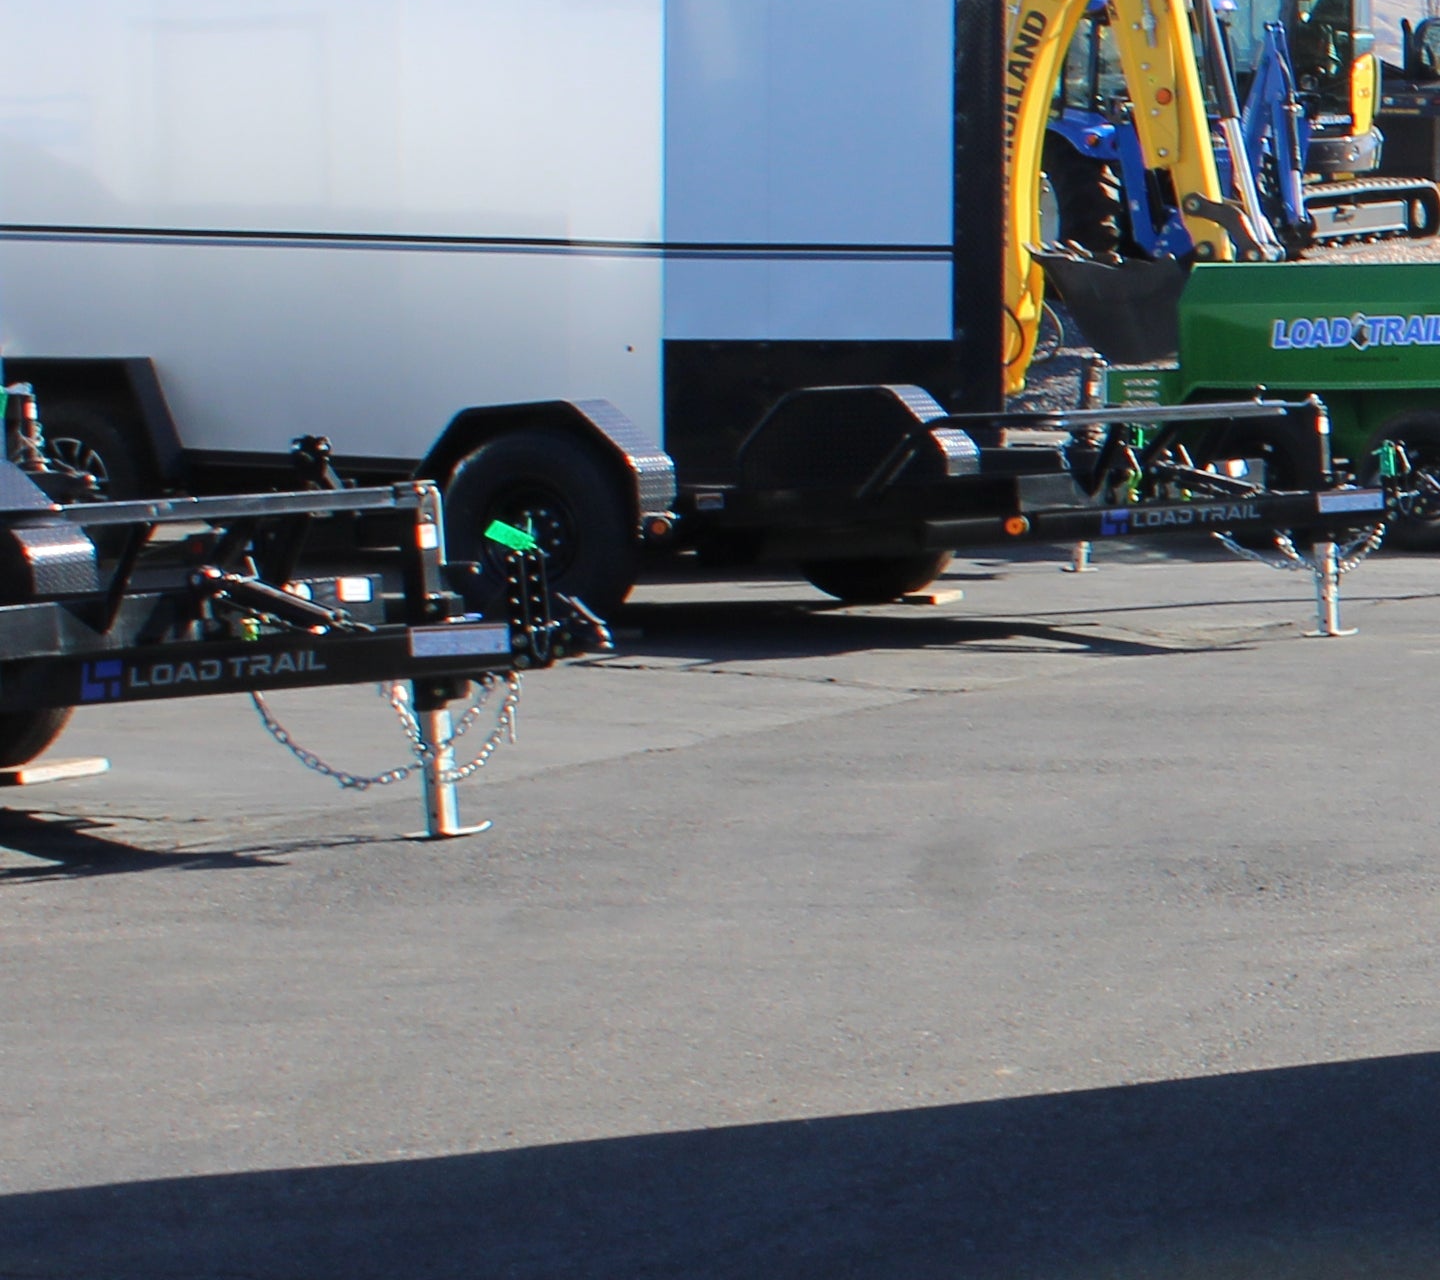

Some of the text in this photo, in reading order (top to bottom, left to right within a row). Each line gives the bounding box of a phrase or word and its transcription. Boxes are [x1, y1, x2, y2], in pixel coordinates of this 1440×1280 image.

[1271, 317, 1351, 349] LOAD
[1132, 510, 1192, 528] LOAD
[1200, 504, 1262, 522] TRAIL
[129, 660, 223, 688] LOAD
[229, 650, 327, 677] TRAIL
